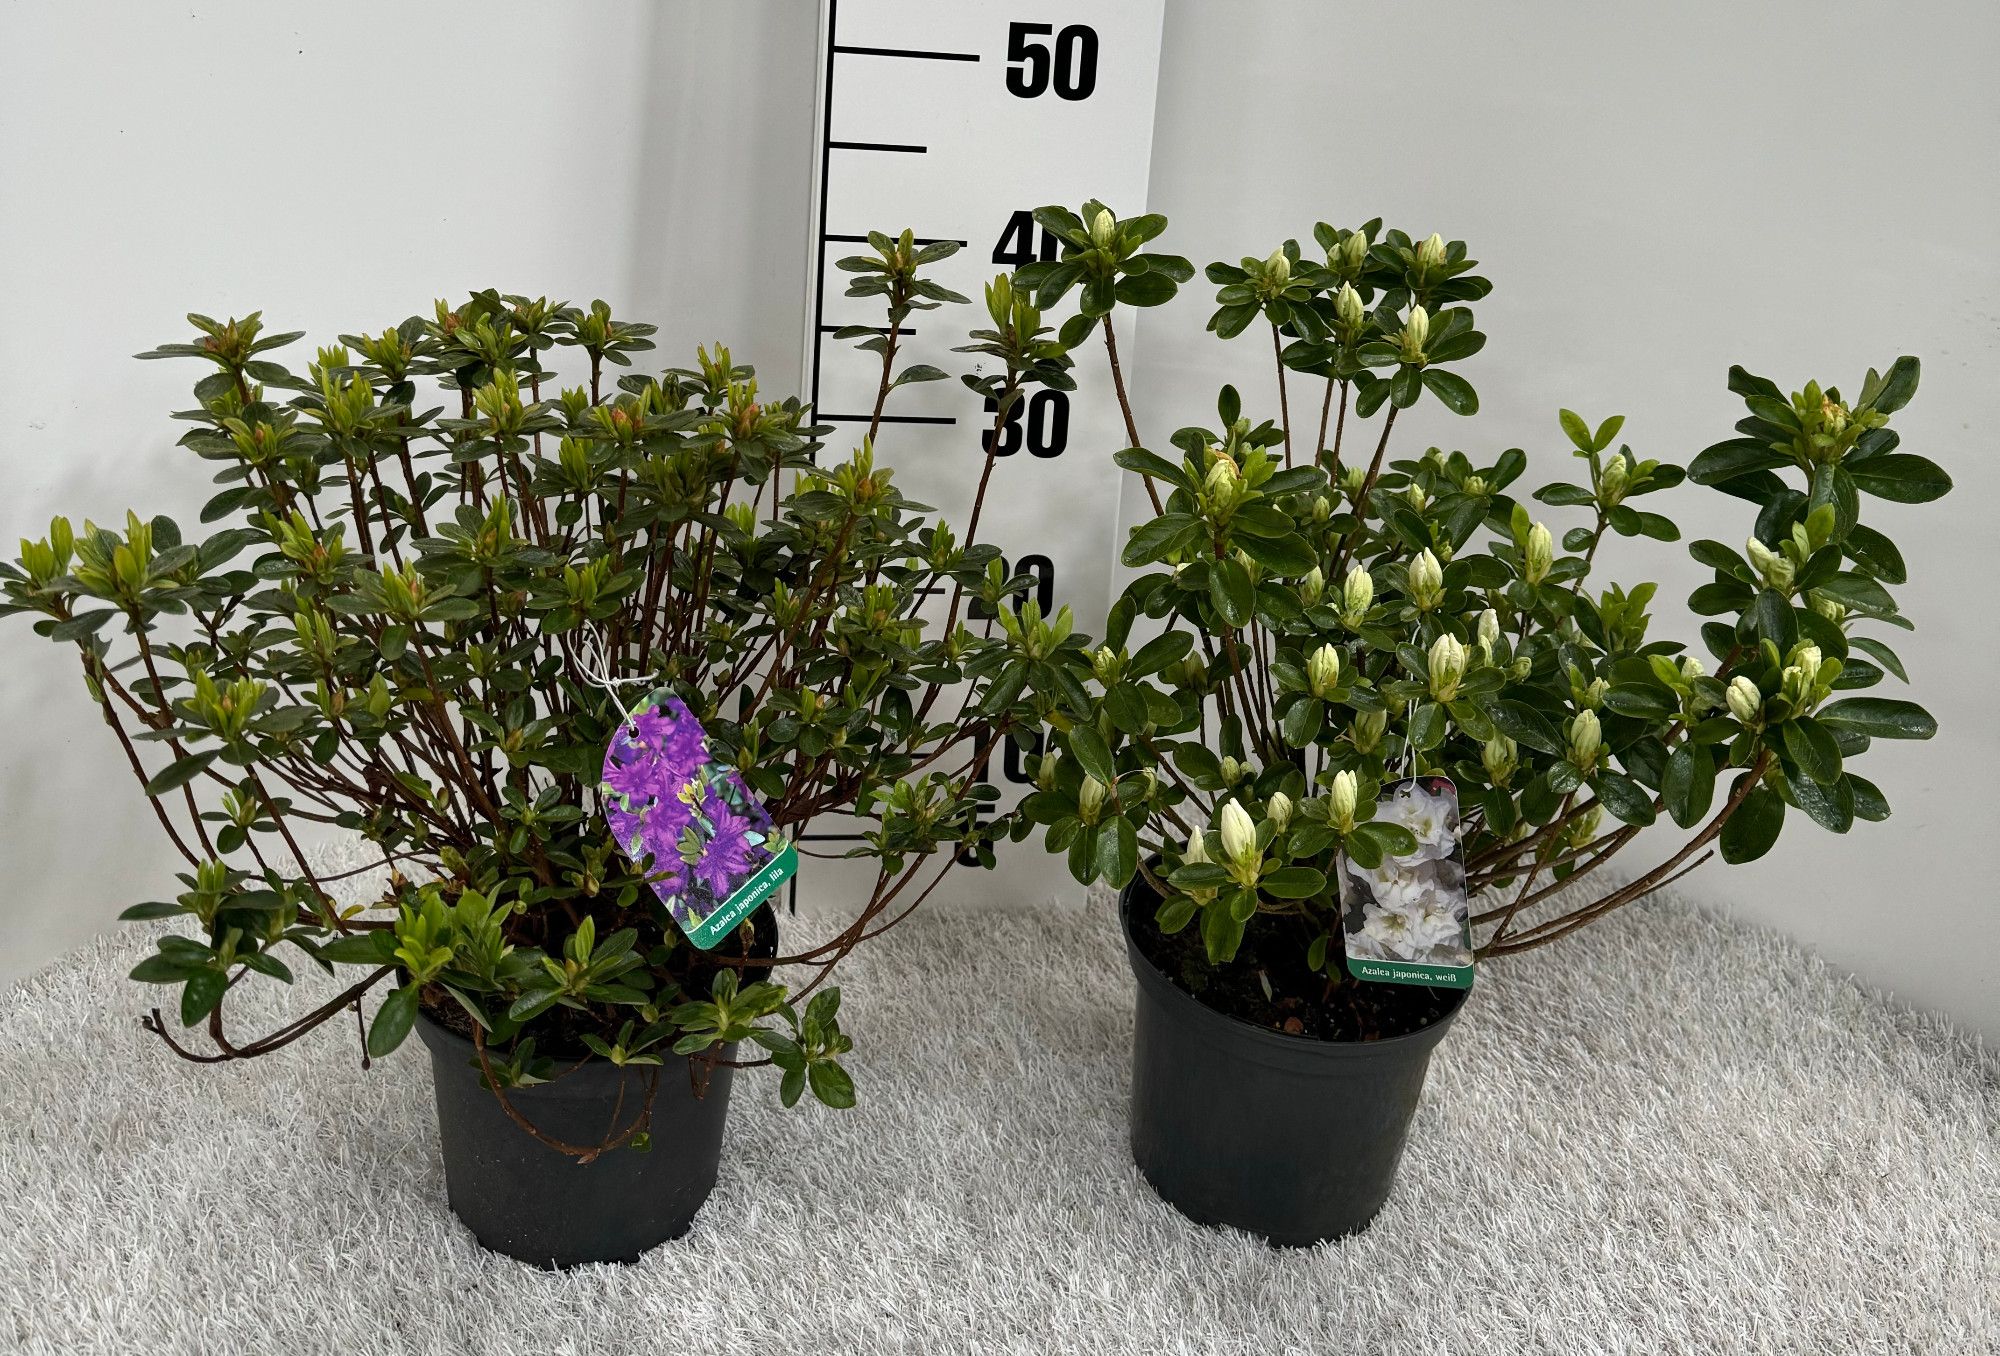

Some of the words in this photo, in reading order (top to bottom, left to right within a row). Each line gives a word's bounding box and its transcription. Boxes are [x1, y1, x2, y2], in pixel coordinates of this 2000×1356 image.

[1005, 21, 1100, 102] 50
[981, 387, 1070, 459] 30
[710, 910, 736, 935] Azalea
[735, 882, 771, 914] japonica,
[769, 868, 784, 882] lila
[1361, 966, 1390, 977] Azalea
[1435, 973, 1457, 982] weiß
